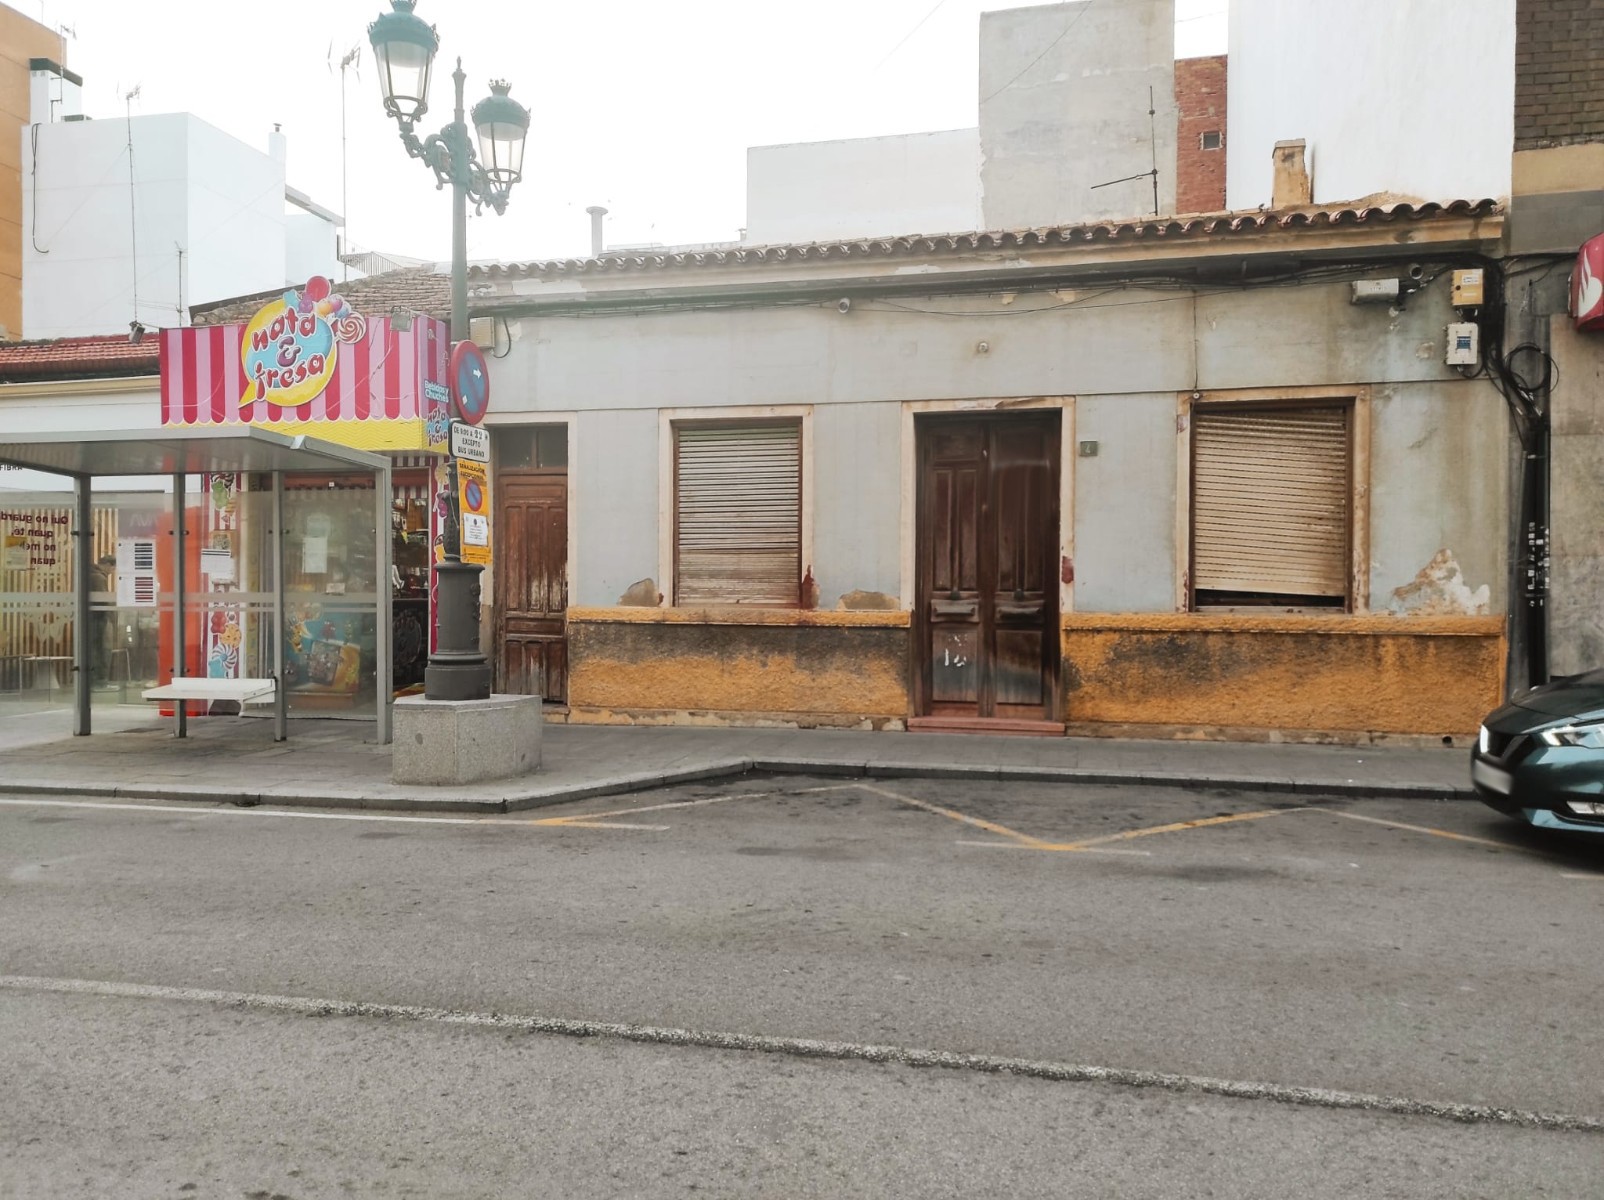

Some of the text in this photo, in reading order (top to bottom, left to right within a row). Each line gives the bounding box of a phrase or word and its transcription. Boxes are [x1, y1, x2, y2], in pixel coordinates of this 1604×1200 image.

[252, 307, 316, 352] nata
[277, 335, 302, 368] &
[255, 354, 325, 400] fresa
[457, 446, 485, 458] BUS URBANO
[461, 437, 481, 448] EXCEPTO
